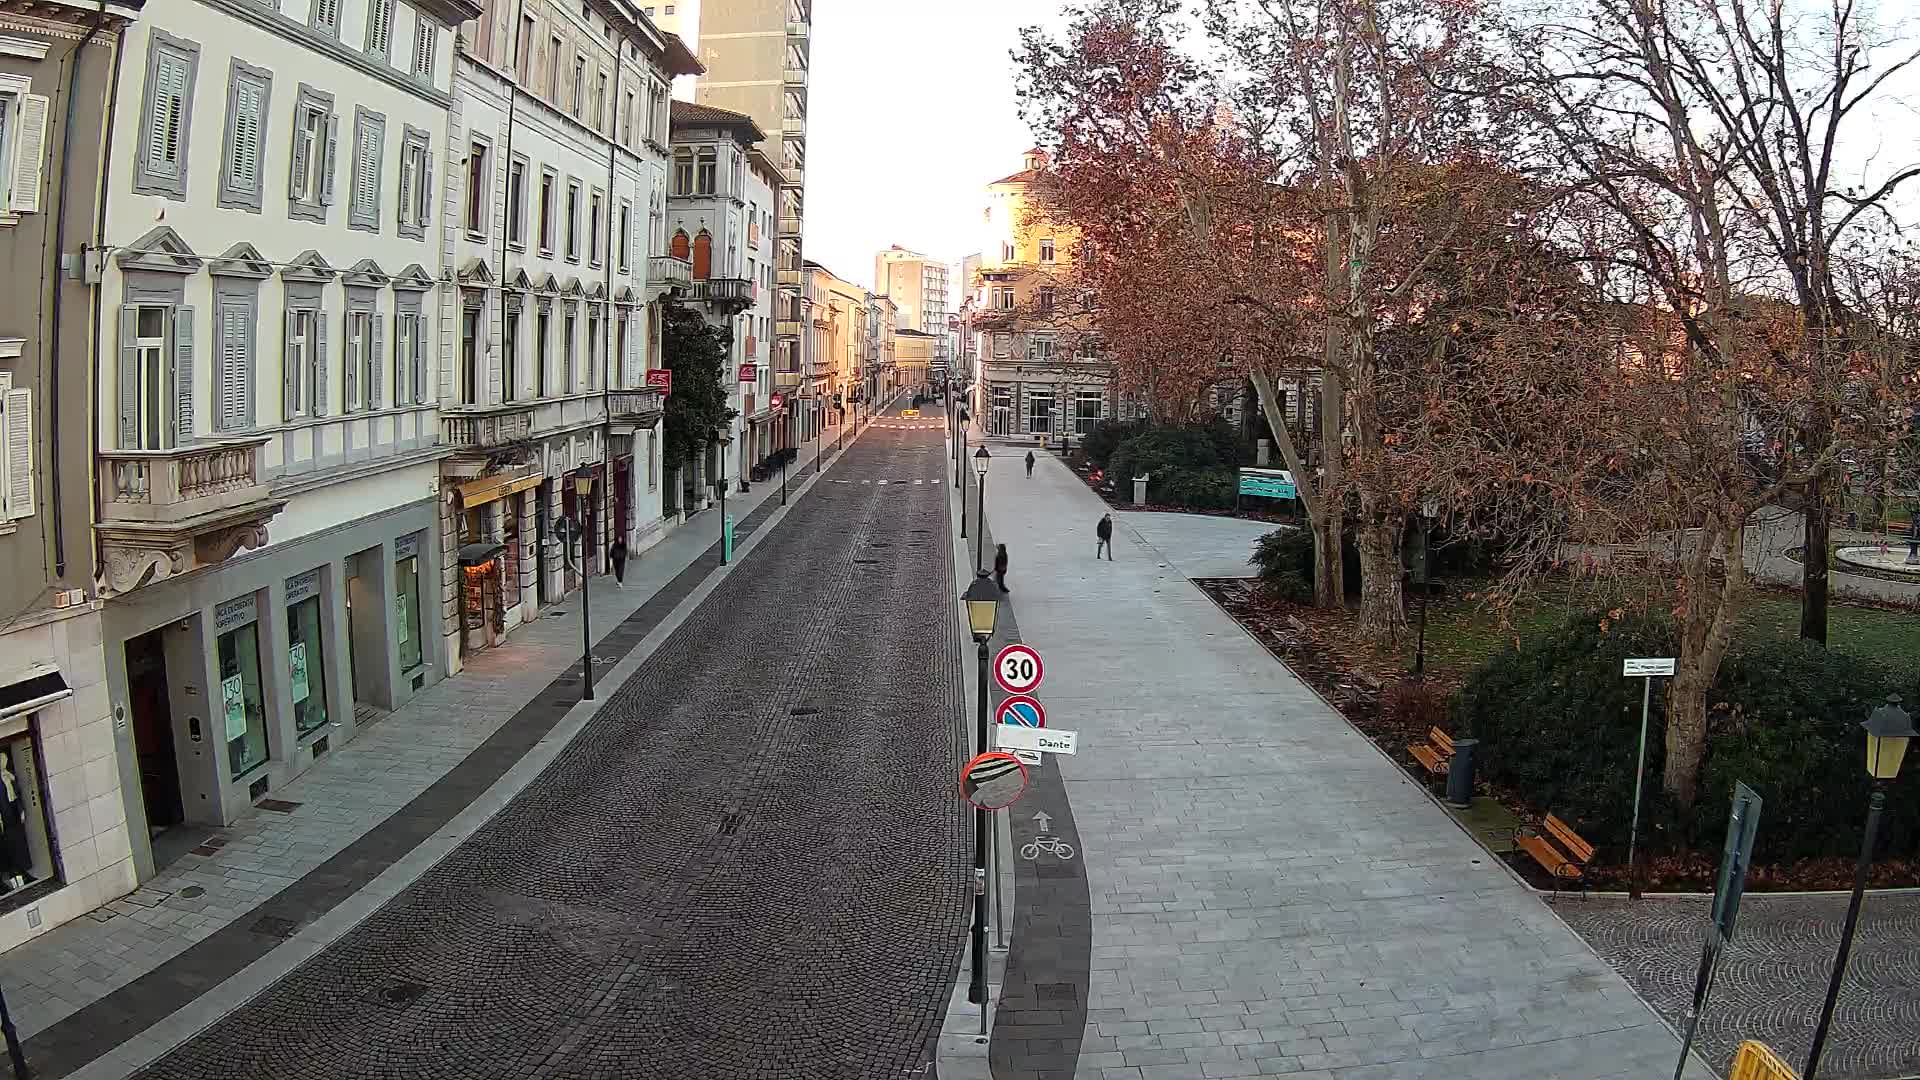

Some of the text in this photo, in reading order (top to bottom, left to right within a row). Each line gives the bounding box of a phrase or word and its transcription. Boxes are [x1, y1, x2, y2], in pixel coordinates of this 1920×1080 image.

[1006, 659, 1032, 680] 30
[224, 677, 240, 702] 130
[1038, 738, 1070, 749] Dante
